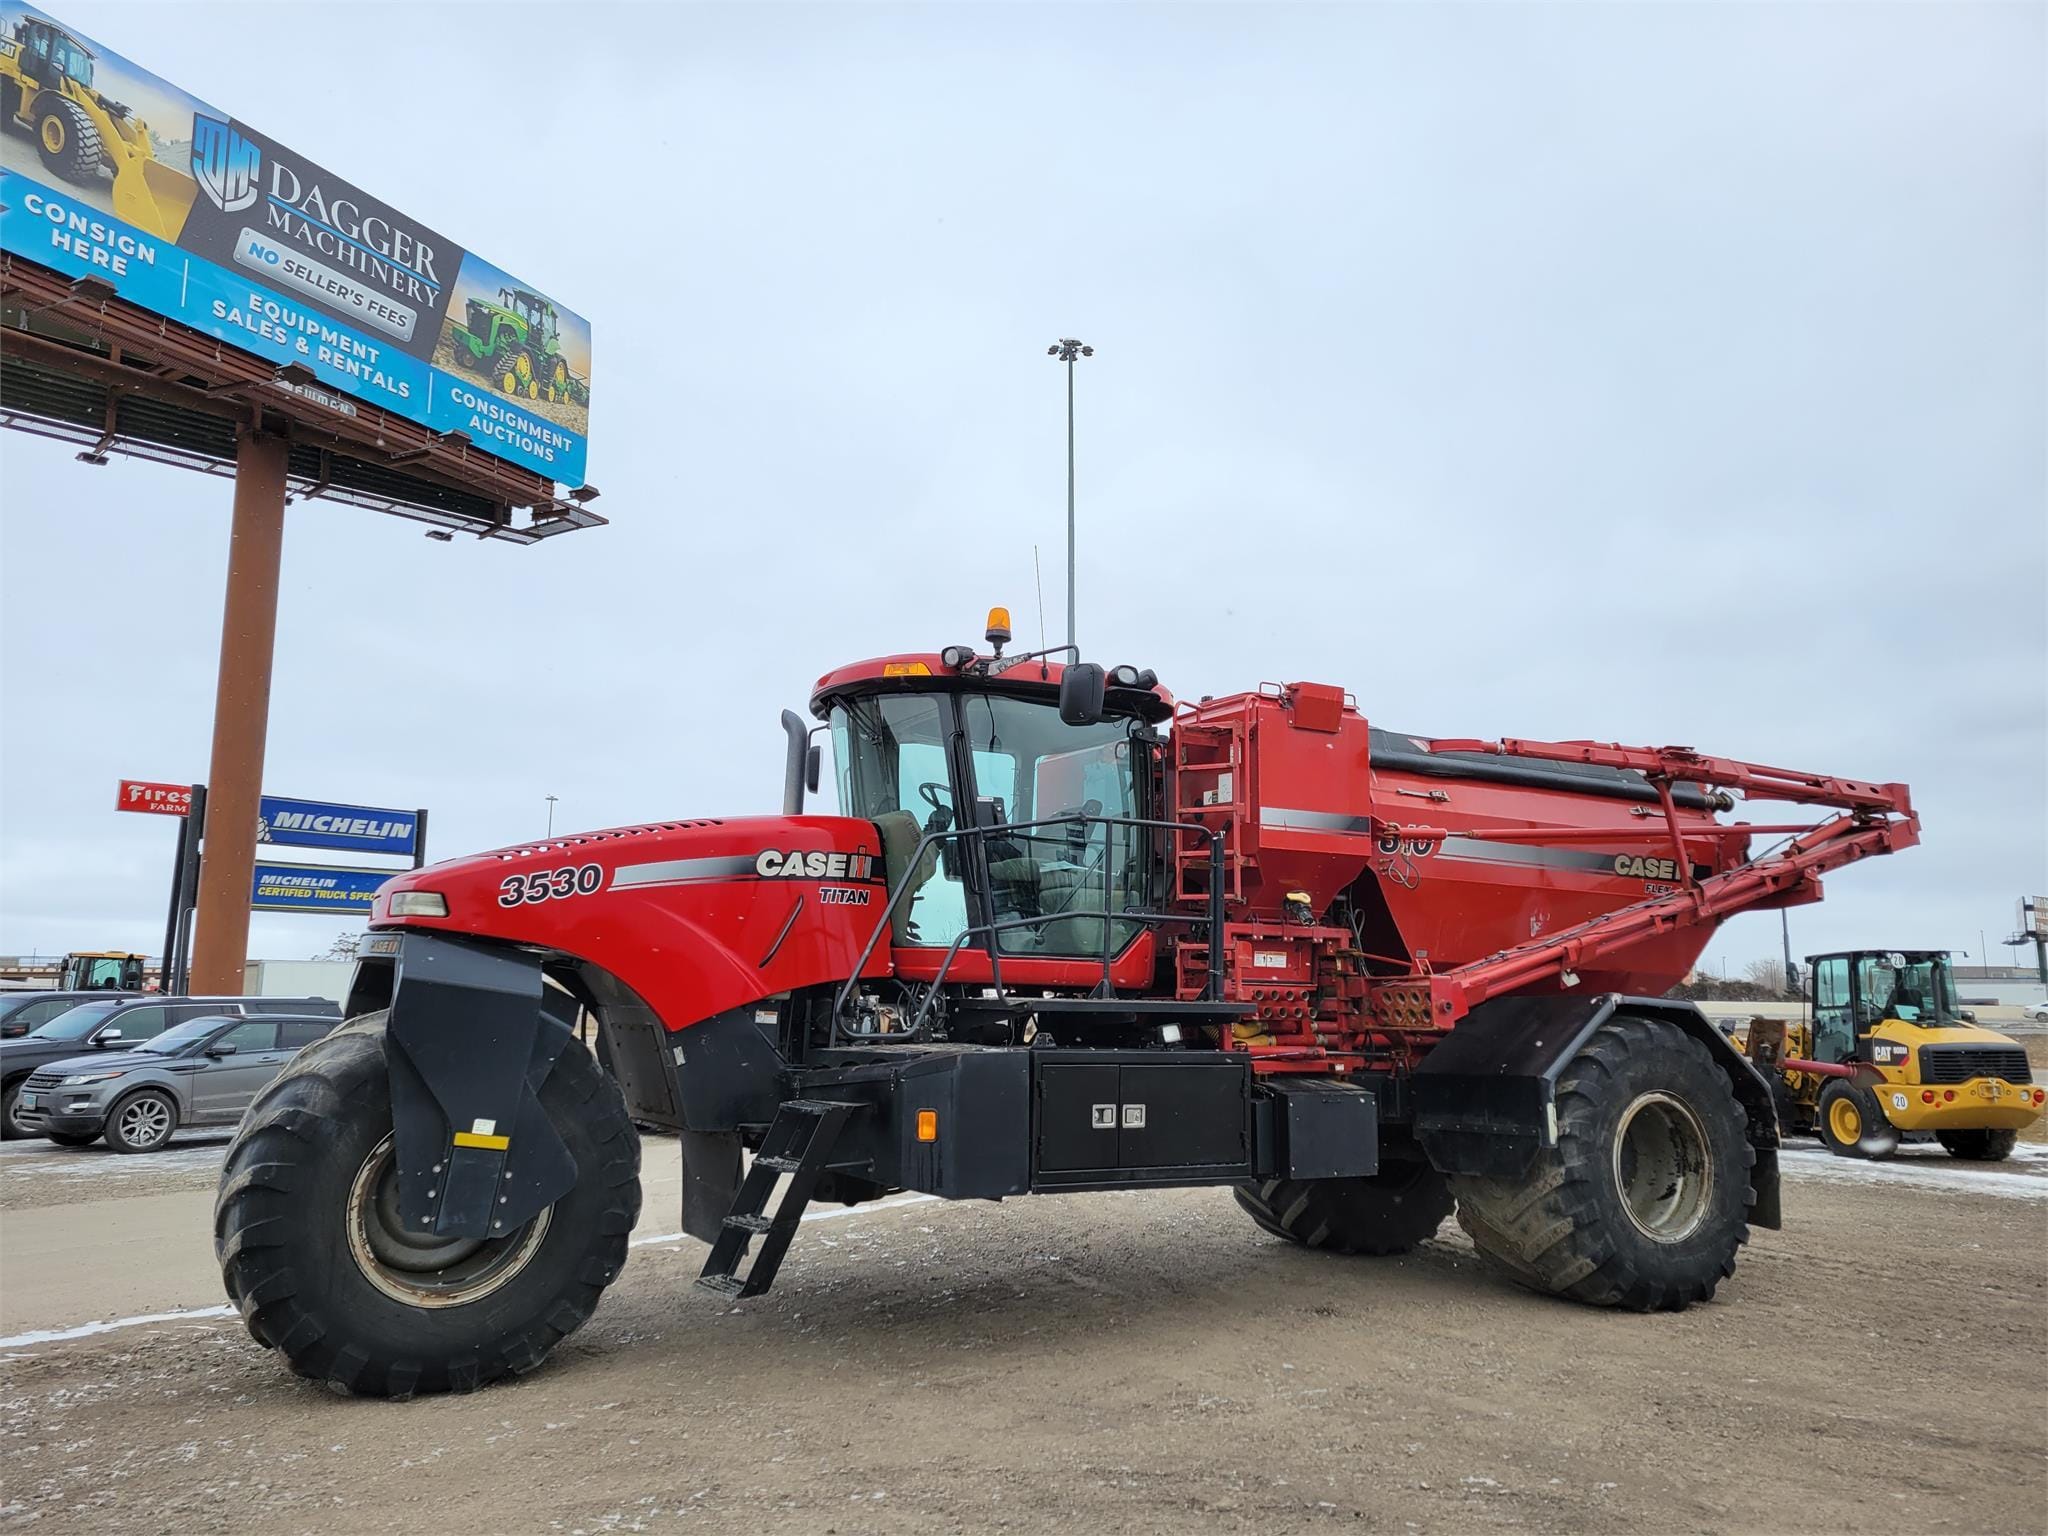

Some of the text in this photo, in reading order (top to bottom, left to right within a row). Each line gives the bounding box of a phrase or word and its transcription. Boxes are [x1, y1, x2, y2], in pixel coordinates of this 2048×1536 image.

[24, 193, 156, 265] CONSIGN
[269, 160, 441, 284] DAGGER
[51, 228, 128, 276] HERE
[266, 202, 441, 309] MACHINERY
[248, 241, 408, 329] NO SELLER'S FEES
[249, 293, 381, 364] EQUIPMENT
[212, 299, 411, 399] SALES & RENTALS
[450, 387, 573, 453] CONSIGNMENT
[469, 414, 555, 462] AUCTIONS
[149, 802, 187, 813] FARM
[273, 811, 413, 839] MICHELIN
[259, 874, 338, 888] MICHELIN
[755, 849, 846, 878] CASE
[1614, 854, 1675, 880] CASE
[257, 886, 312, 898] CERTIFIED
[314, 889, 347, 901] TRUCK
[497, 862, 604, 908] 3530
[818, 886, 870, 906] TITAN
[1893, 954, 1905, 967] 20
[1874, 1046, 1891, 1062] CAT
[1894, 1095, 1906, 1108] 20
